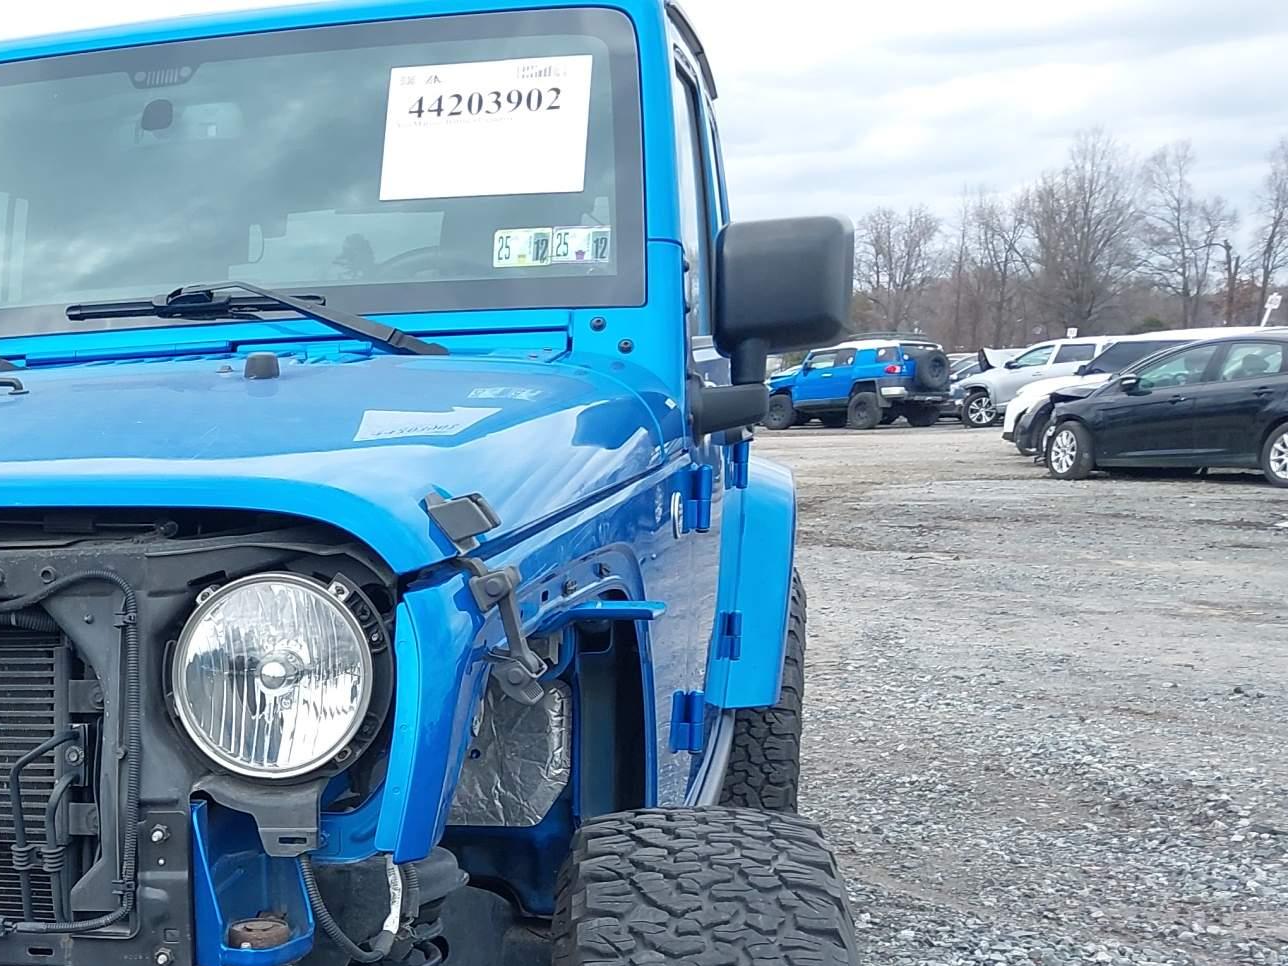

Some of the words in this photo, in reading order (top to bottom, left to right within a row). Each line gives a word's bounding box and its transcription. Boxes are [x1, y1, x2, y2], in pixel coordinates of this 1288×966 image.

[408, 87, 562, 118] 44203902
[497, 235, 511, 261] 25
[556, 232, 570, 257] 25
